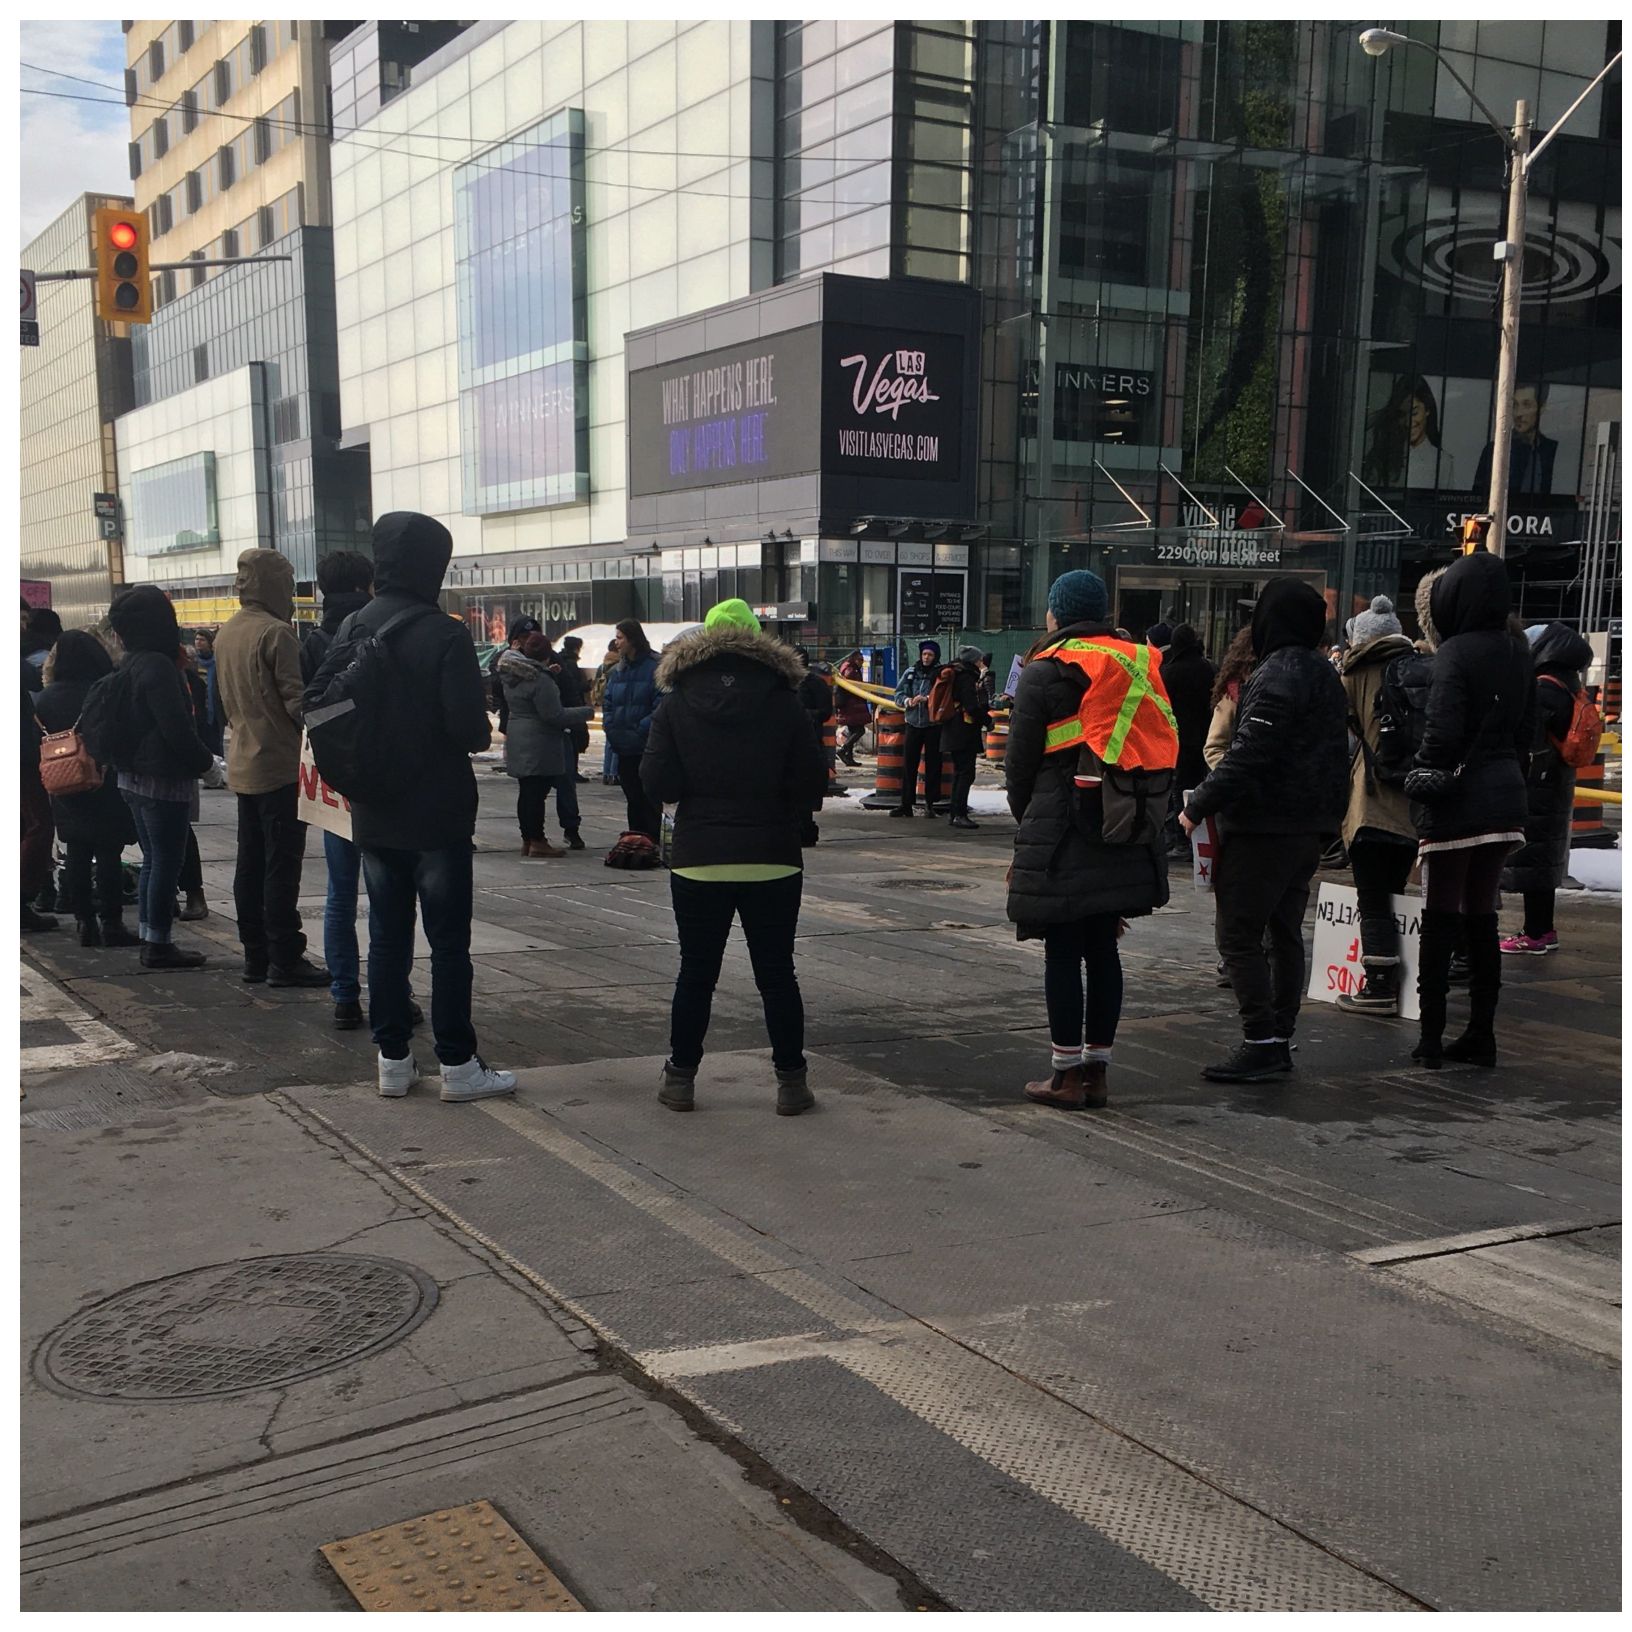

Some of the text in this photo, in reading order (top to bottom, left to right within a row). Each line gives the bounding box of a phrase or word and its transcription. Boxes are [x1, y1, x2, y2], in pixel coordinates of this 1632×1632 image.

[899, 353, 923, 372] LAS
[662, 354, 777, 424] WHAT HAPPENS HERE,
[841, 353, 940, 421] Vegas
[840, 430, 938, 461] VISITLASVEGAS.COM
[104, 520, 115, 536] P
[1446, 512, 1553, 535] SEORA
[874, 551, 891, 560] OVER
[910, 552, 931, 561] SHOPS
[1158, 545, 1190, 559] 2290
[1241, 548, 1280, 563] Street
